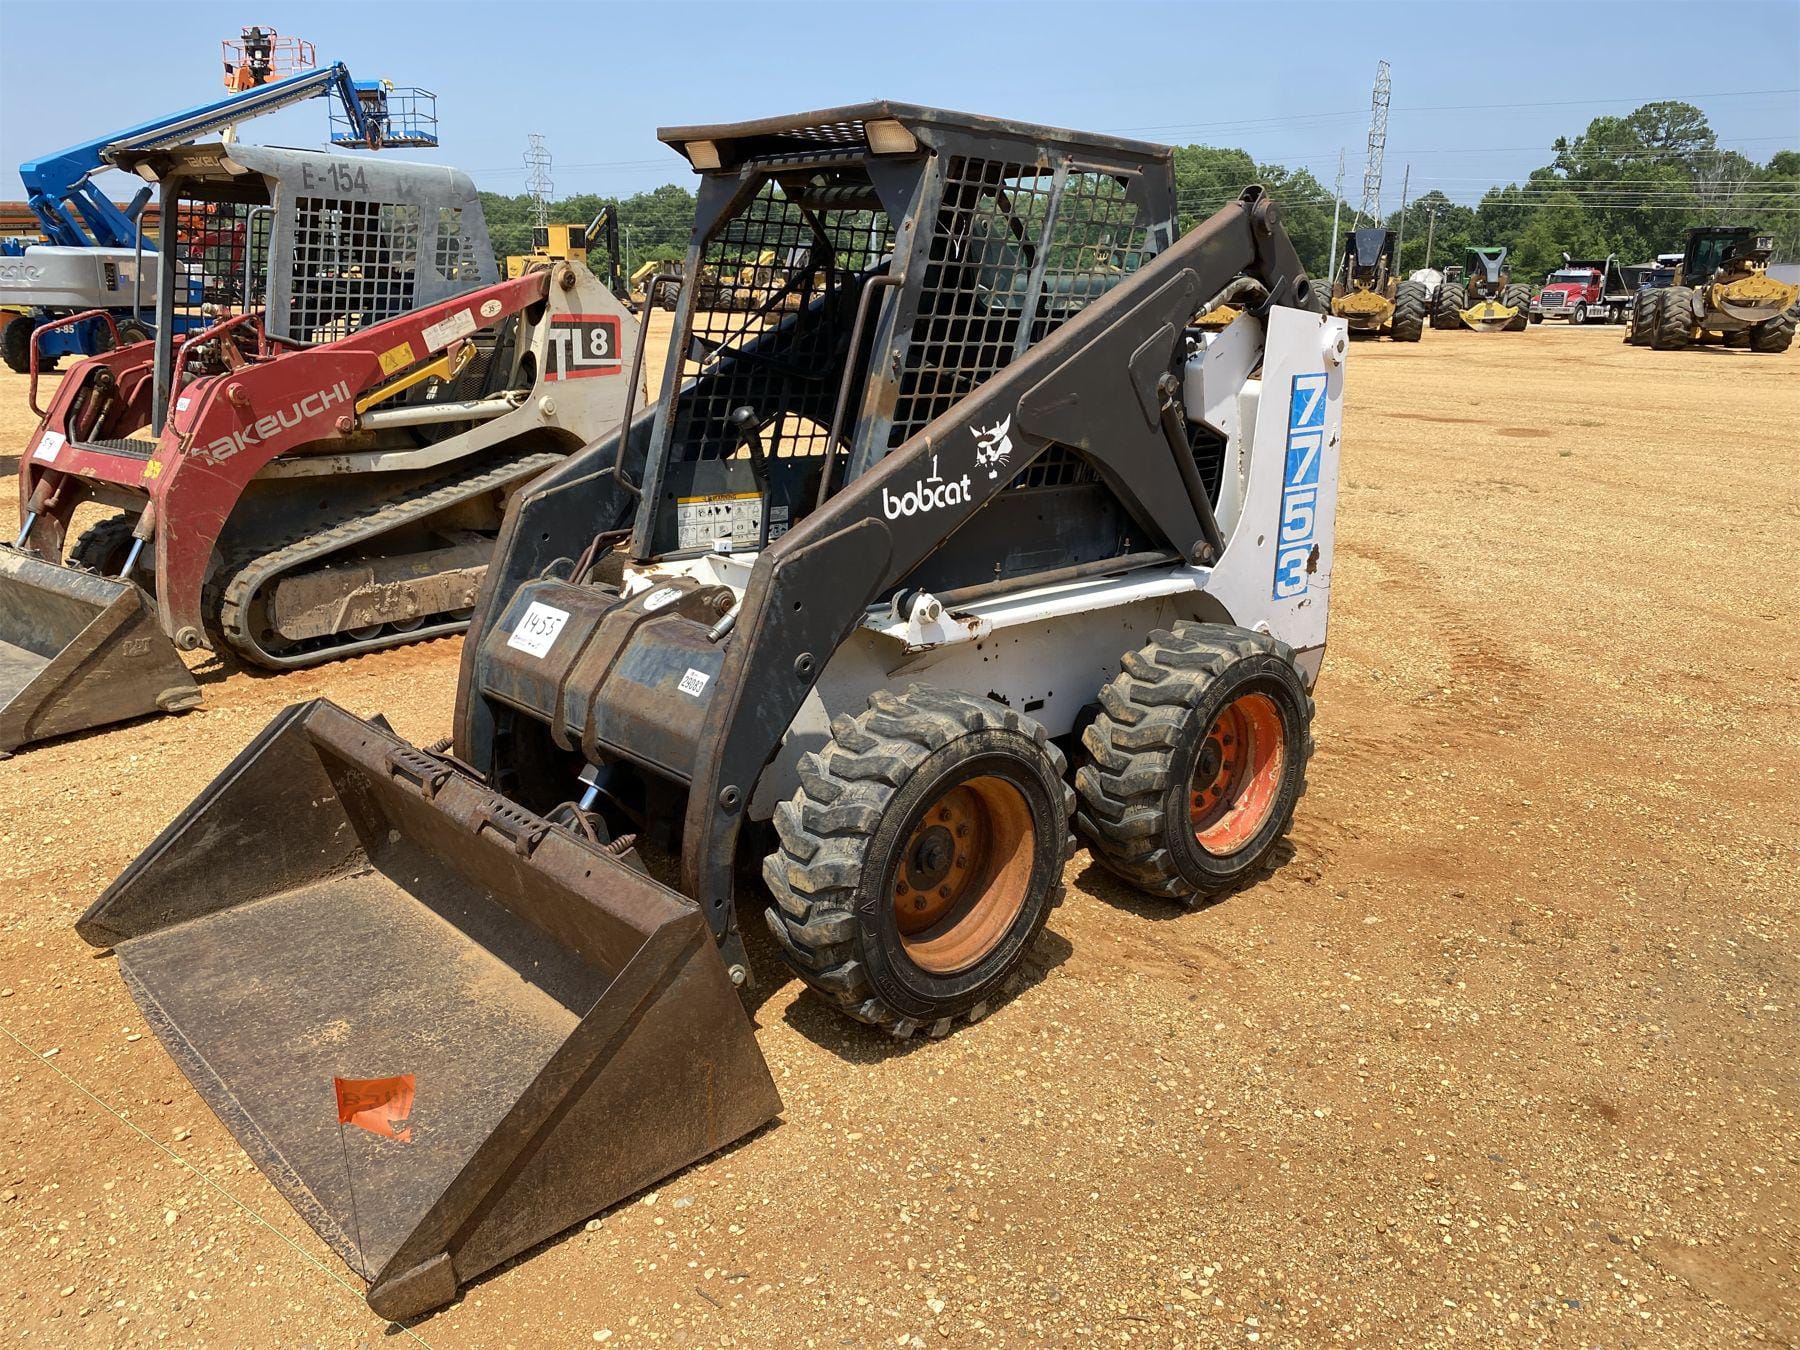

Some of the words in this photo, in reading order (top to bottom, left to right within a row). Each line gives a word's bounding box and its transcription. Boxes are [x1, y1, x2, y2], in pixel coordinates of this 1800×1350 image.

[302, 162, 368, 194] E-154
[549, 328, 622, 380] TL8
[882, 474, 971, 520] bobcat
[1277, 375, 1328, 597] 7753
[523, 611, 562, 636] 1455
